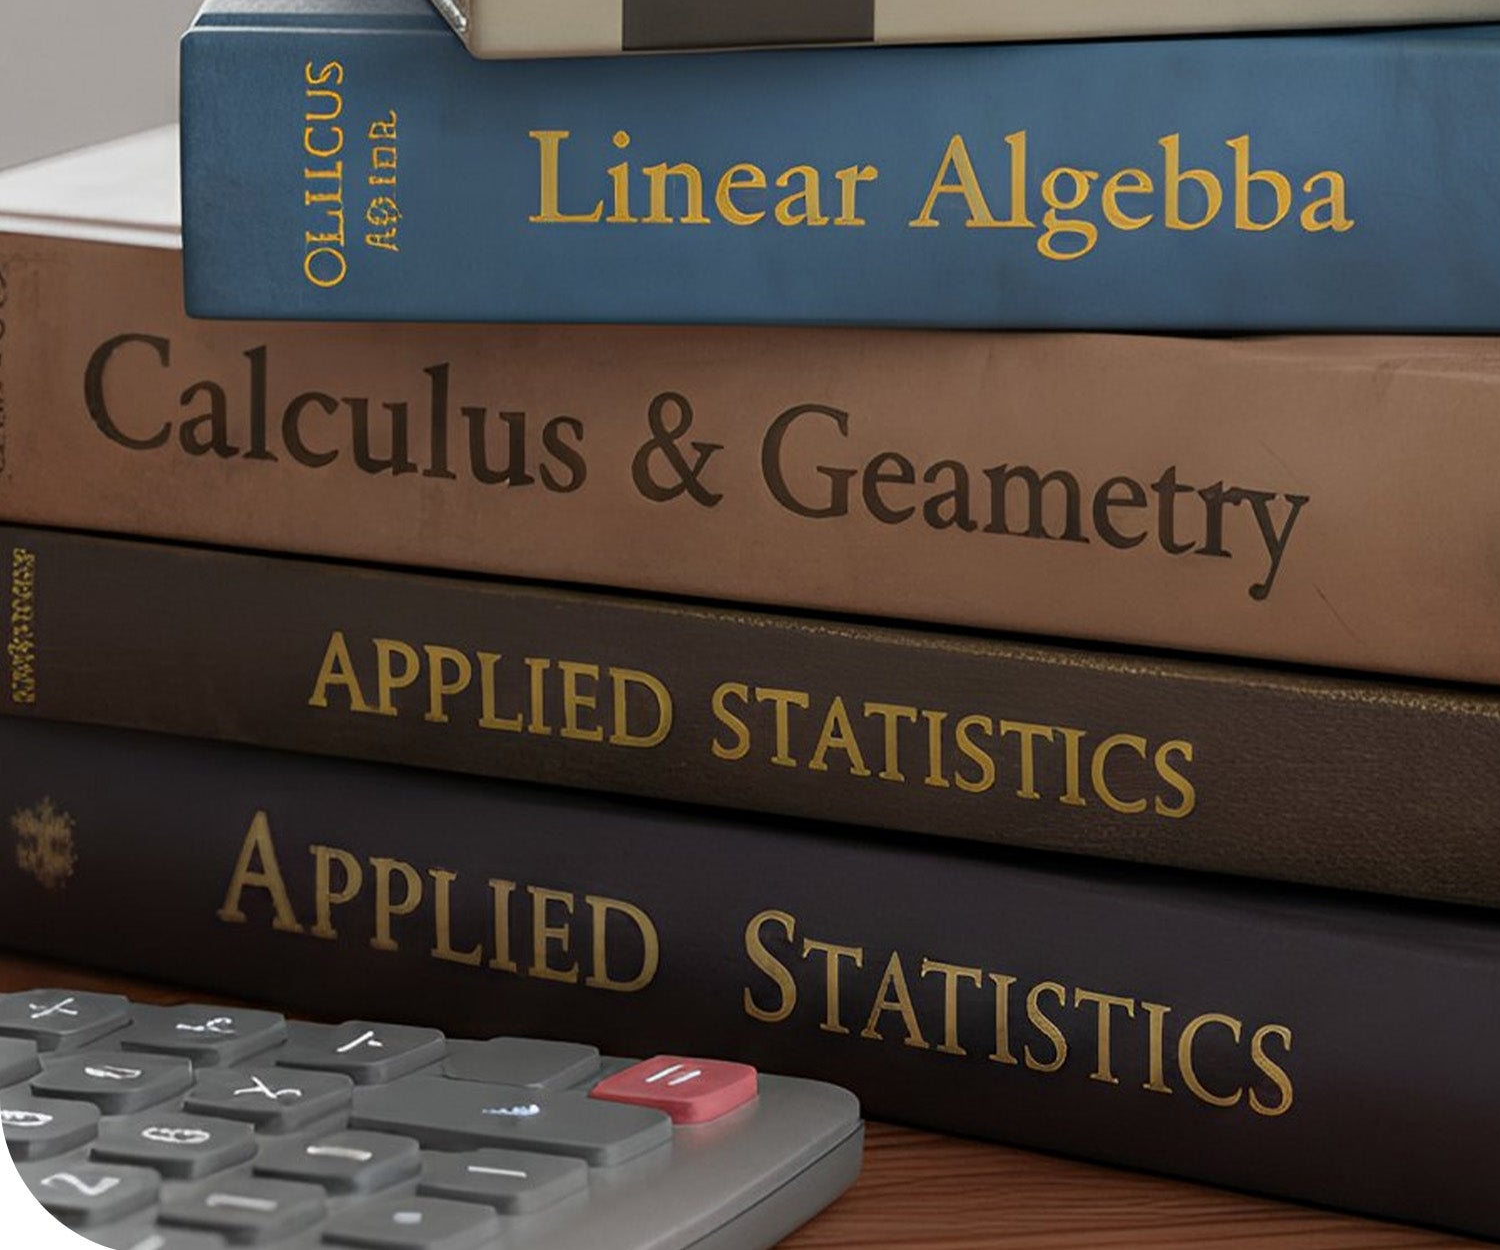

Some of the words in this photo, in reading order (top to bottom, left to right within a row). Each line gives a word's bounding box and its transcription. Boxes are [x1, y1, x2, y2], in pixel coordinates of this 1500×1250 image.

[529, 131, 878, 226] Linear
[911, 131, 1354, 260] Algebba
[84, 334, 587, 493] Calculus
[632, 392, 724, 508] &
[761, 403, 1310, 601] Geametry
[309, 632, 672, 747] APPLIED
[712, 683, 1194, 818] STATISTICS
[218, 813, 658, 990] APPLIED
[743, 909, 1294, 1116] STATISTICS
